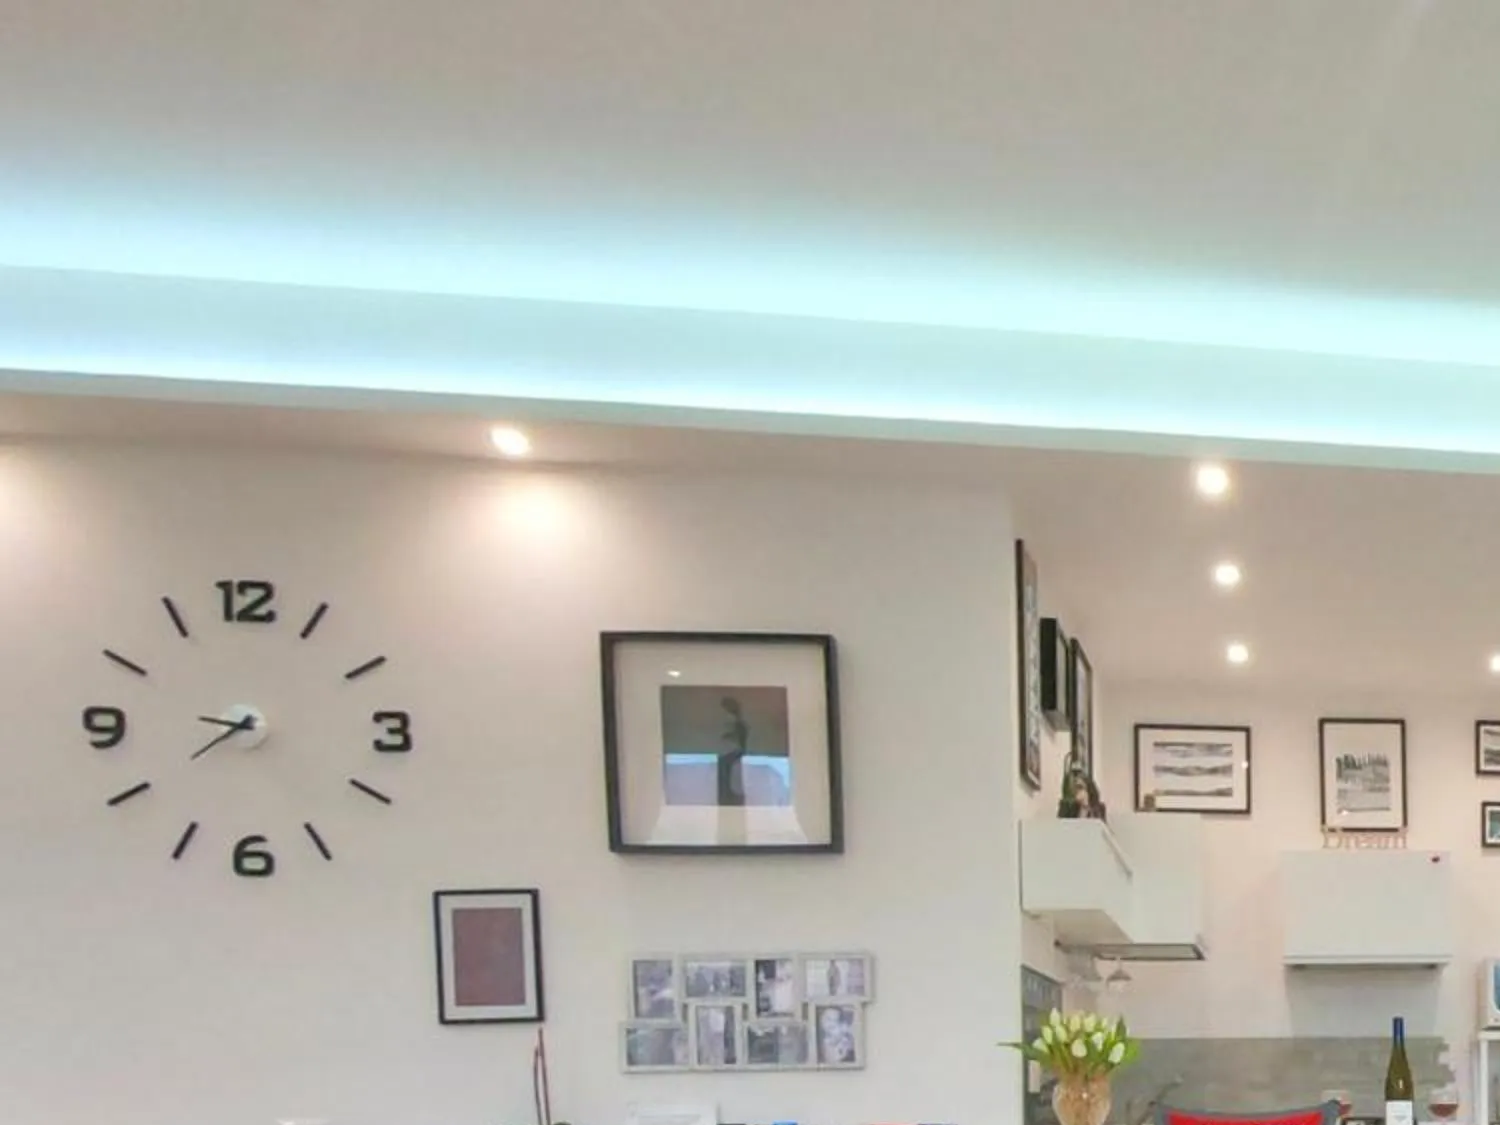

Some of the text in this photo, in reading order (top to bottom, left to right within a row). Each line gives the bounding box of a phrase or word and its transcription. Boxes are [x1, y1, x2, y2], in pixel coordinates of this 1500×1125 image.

[215, 579, 277, 624] 12
[82, 705, 127, 750] 9
[372, 710, 413, 754] 3
[232, 834, 276, 878] 6
